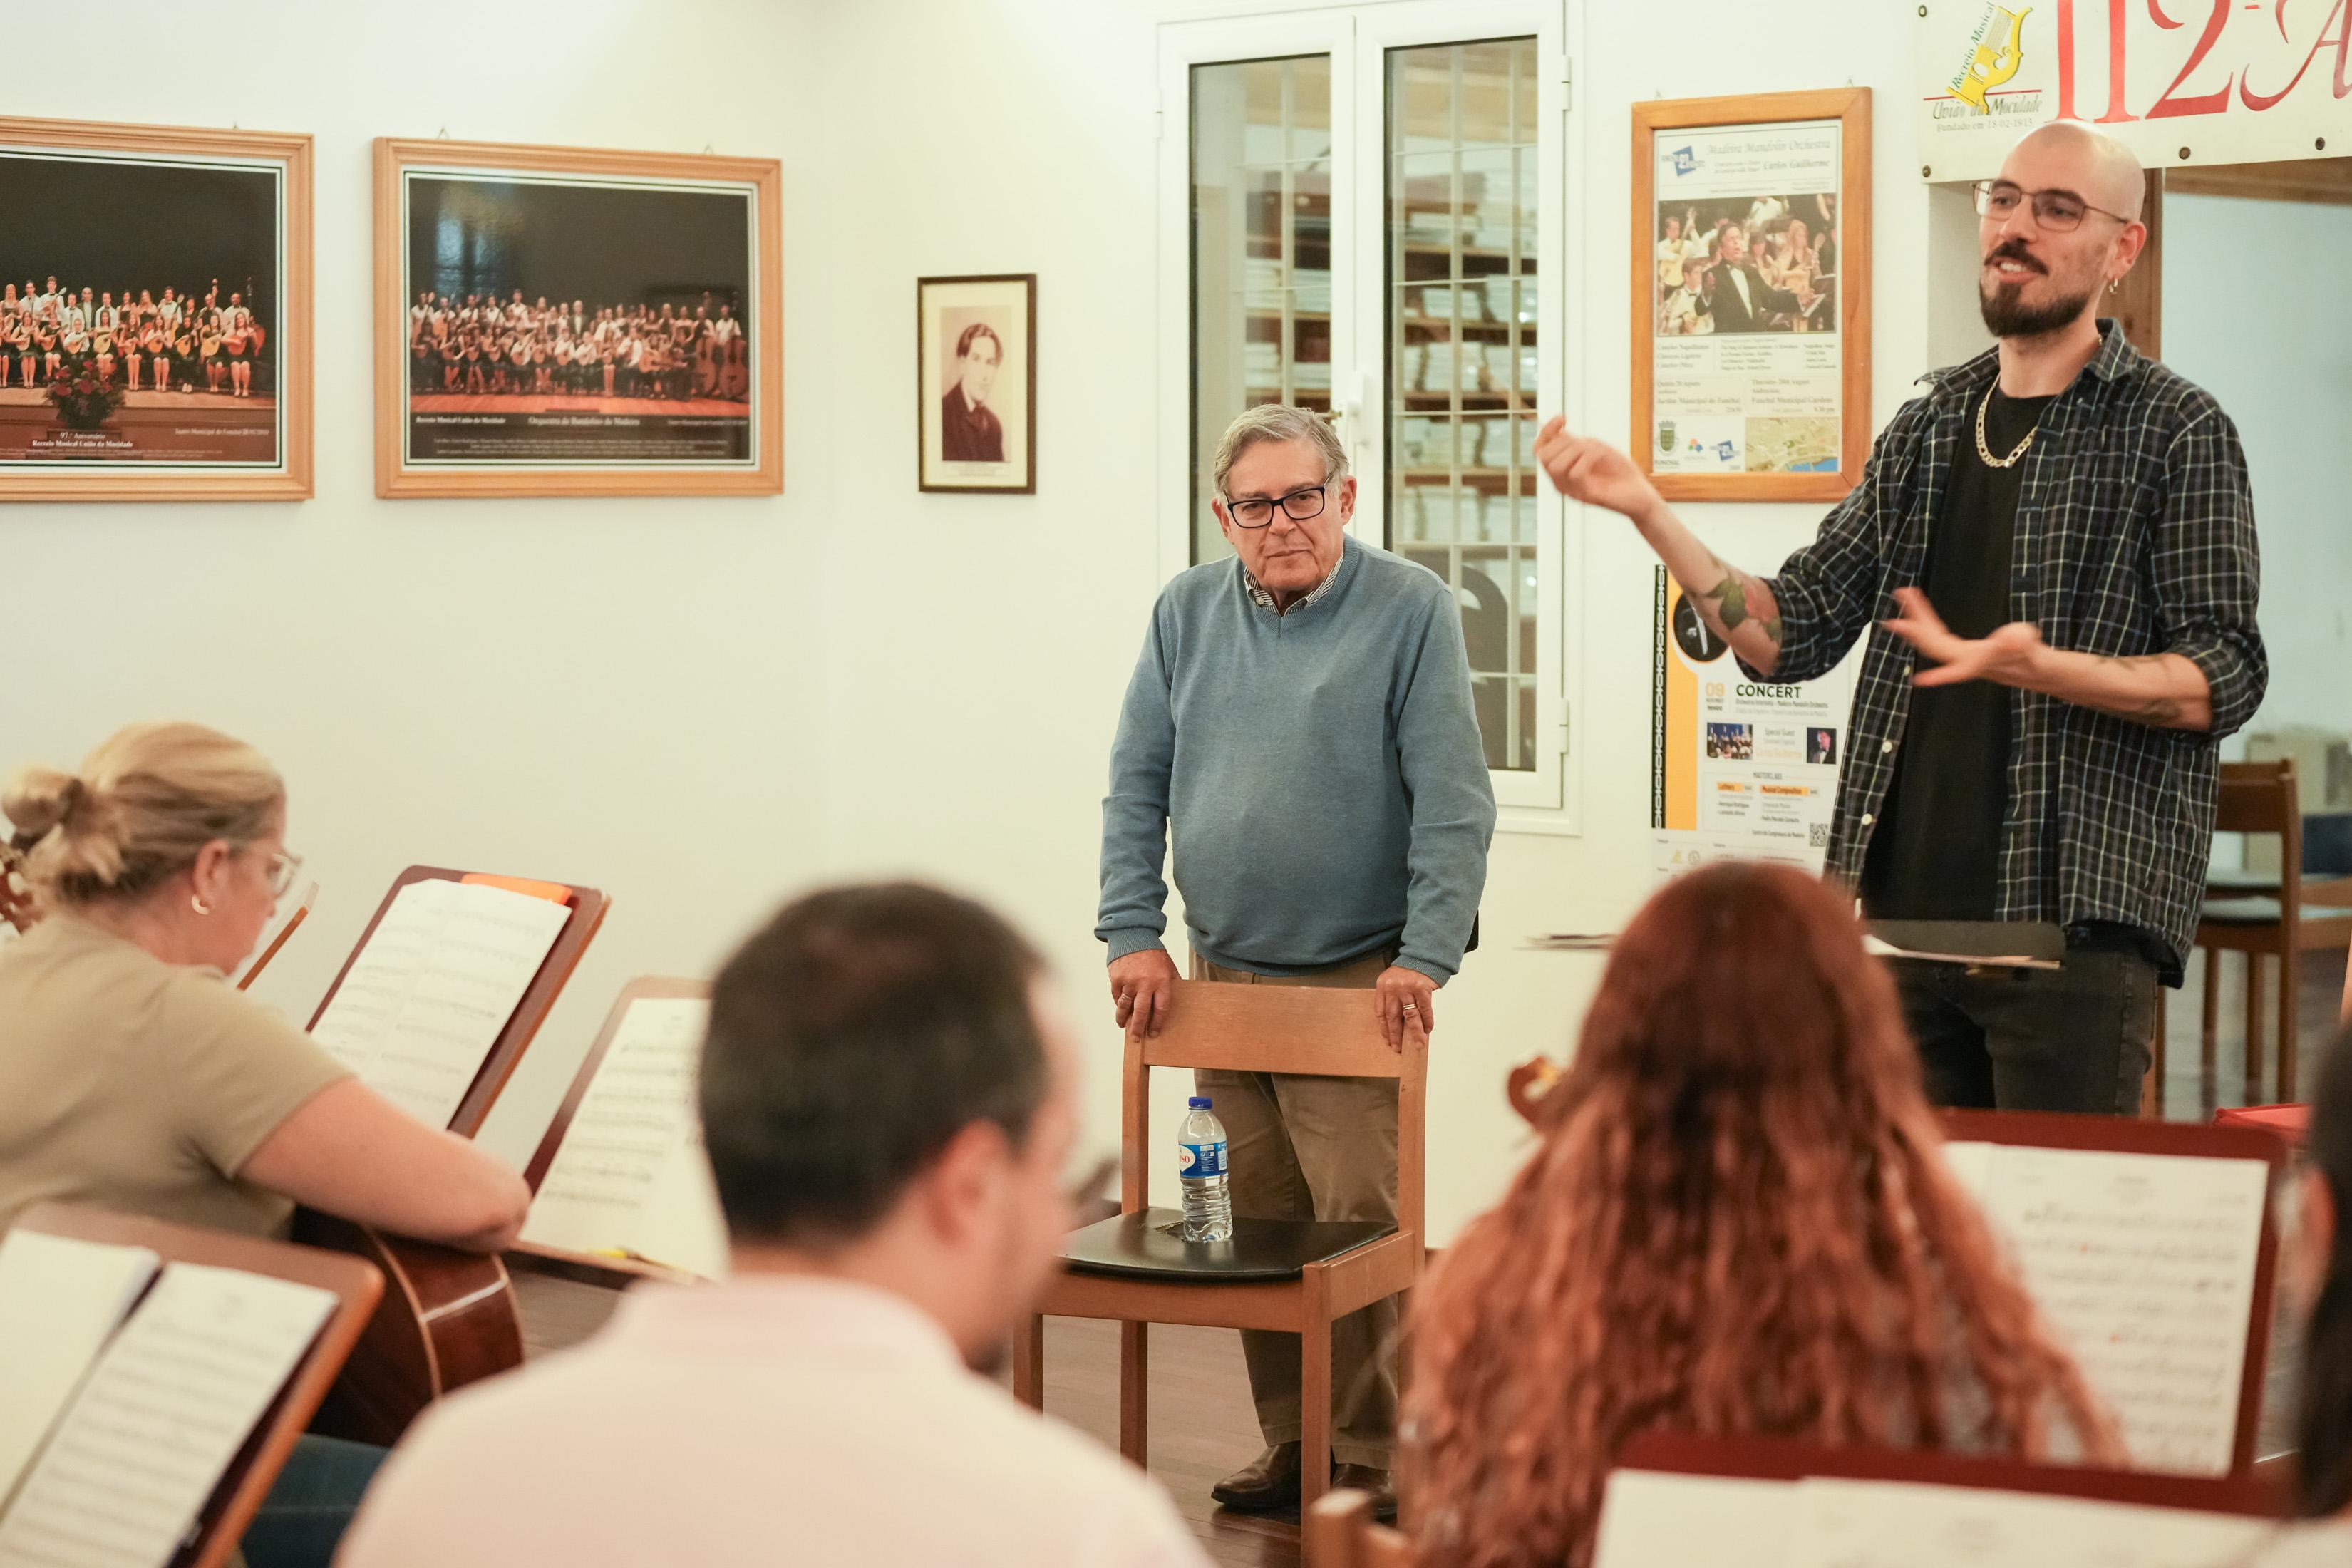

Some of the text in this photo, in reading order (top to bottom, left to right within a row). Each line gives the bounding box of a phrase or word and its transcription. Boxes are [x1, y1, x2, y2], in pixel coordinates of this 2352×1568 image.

[1951, 1, 1996, 88] Recreio Musical
[1991, 94, 2042, 116] Mocidade
[1936, 123, 1970, 133] Fundado
[1744, 139, 1787, 153] Mandolin
[1789, 138, 1830, 151] Orchestra
[1763, 159, 1788, 170] Carlos
[1790, 158, 1830, 168] Guilherme
[1735, 684, 1802, 698] CONCERT
